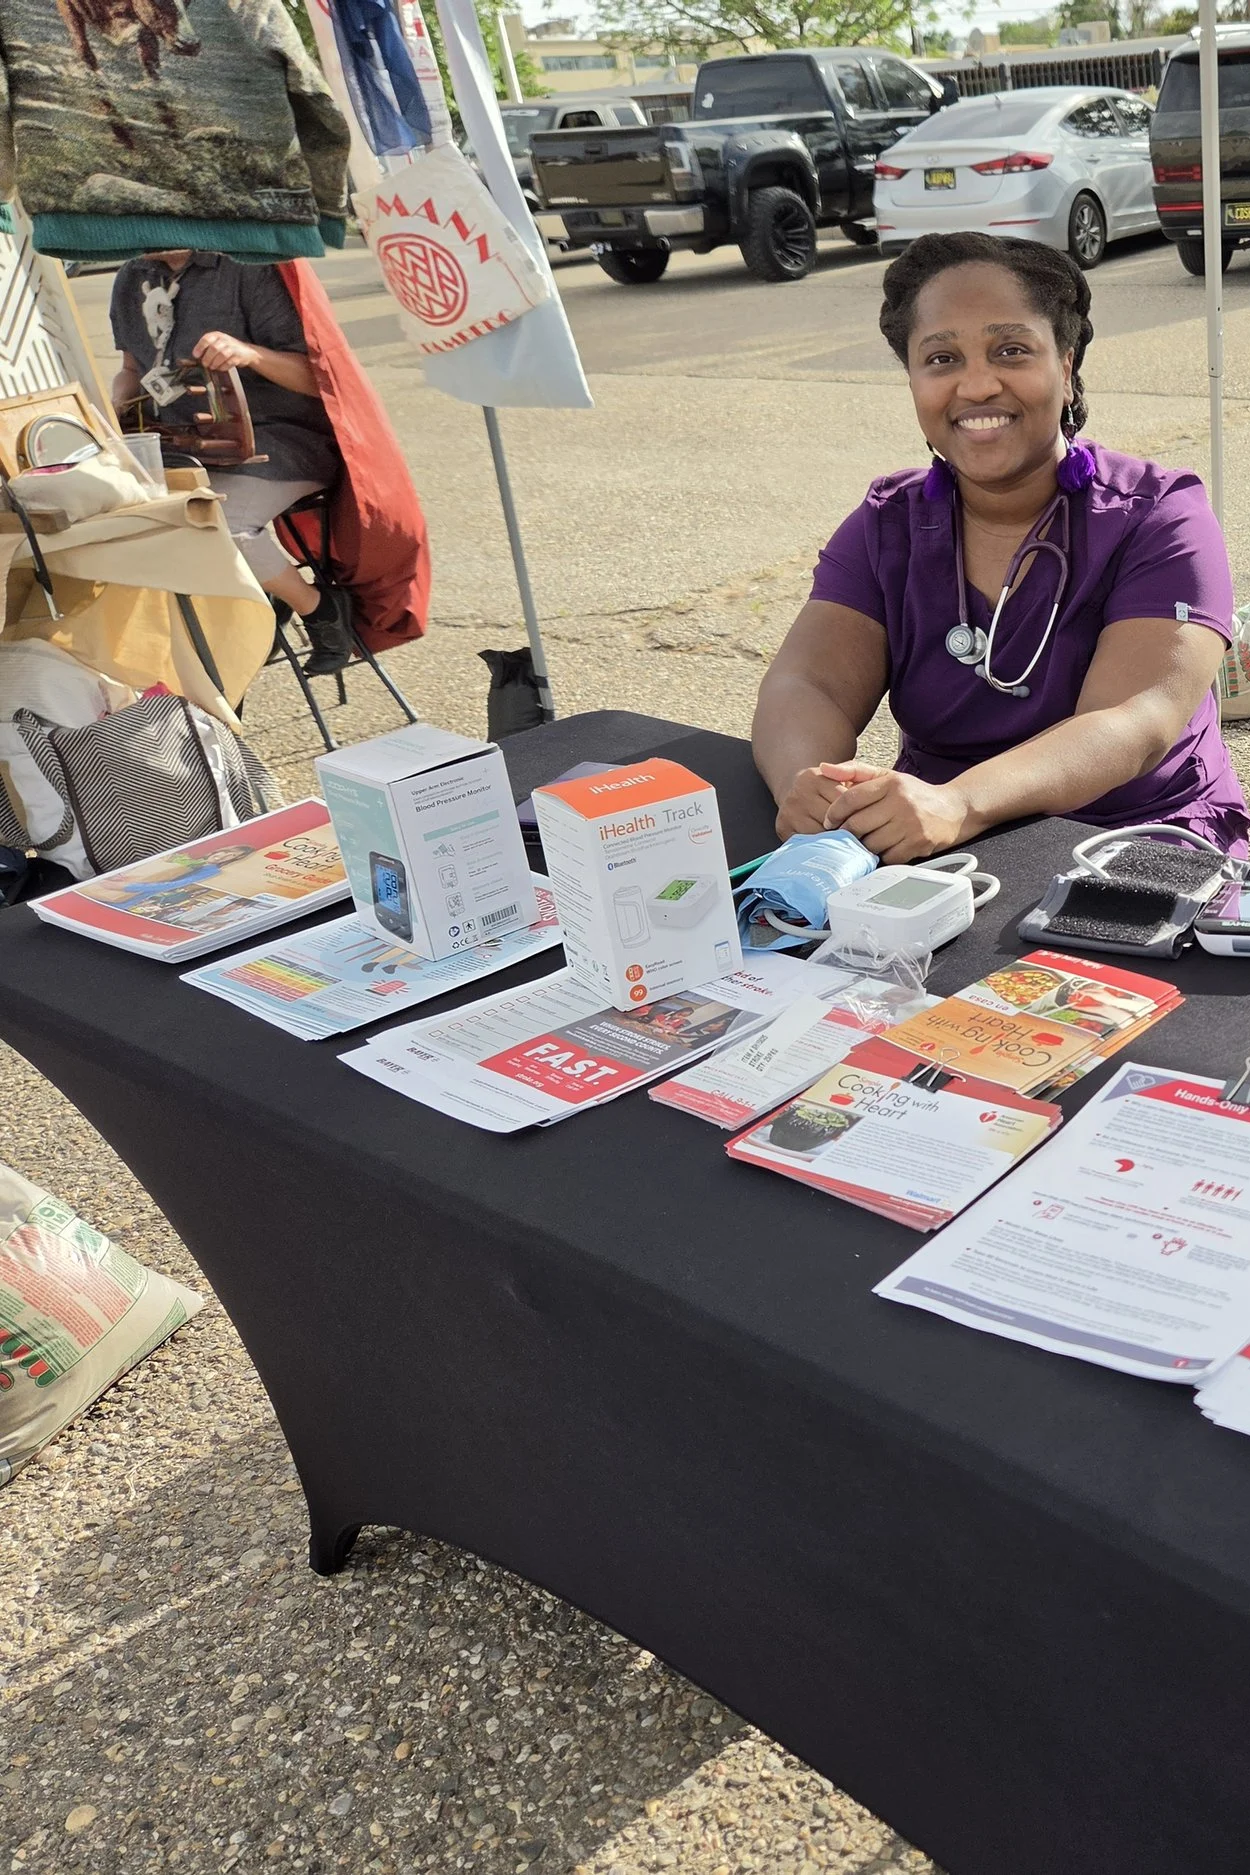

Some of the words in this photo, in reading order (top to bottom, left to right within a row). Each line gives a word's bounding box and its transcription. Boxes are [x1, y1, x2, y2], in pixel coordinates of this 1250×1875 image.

[588, 774, 656, 795] iHealth
[415, 801, 436, 813] Blood
[436, 792, 467, 808] Pressure
[467, 785, 492, 798] Monitor
[599, 815, 656, 841] iHealth
[663, 802, 704, 824] Track
[927, 1014, 961, 1033] with
[969, 1012, 1034, 1040] Heart
[965, 1026, 1053, 1067] Cooking
[376, 1057, 405, 1072] BAYER
[838, 1074, 911, 1111] Cooking
[911, 1097, 940, 1114] with
[853, 1096, 909, 1120] Heart
[1174, 1088, 1249, 1117] Hands-Only
